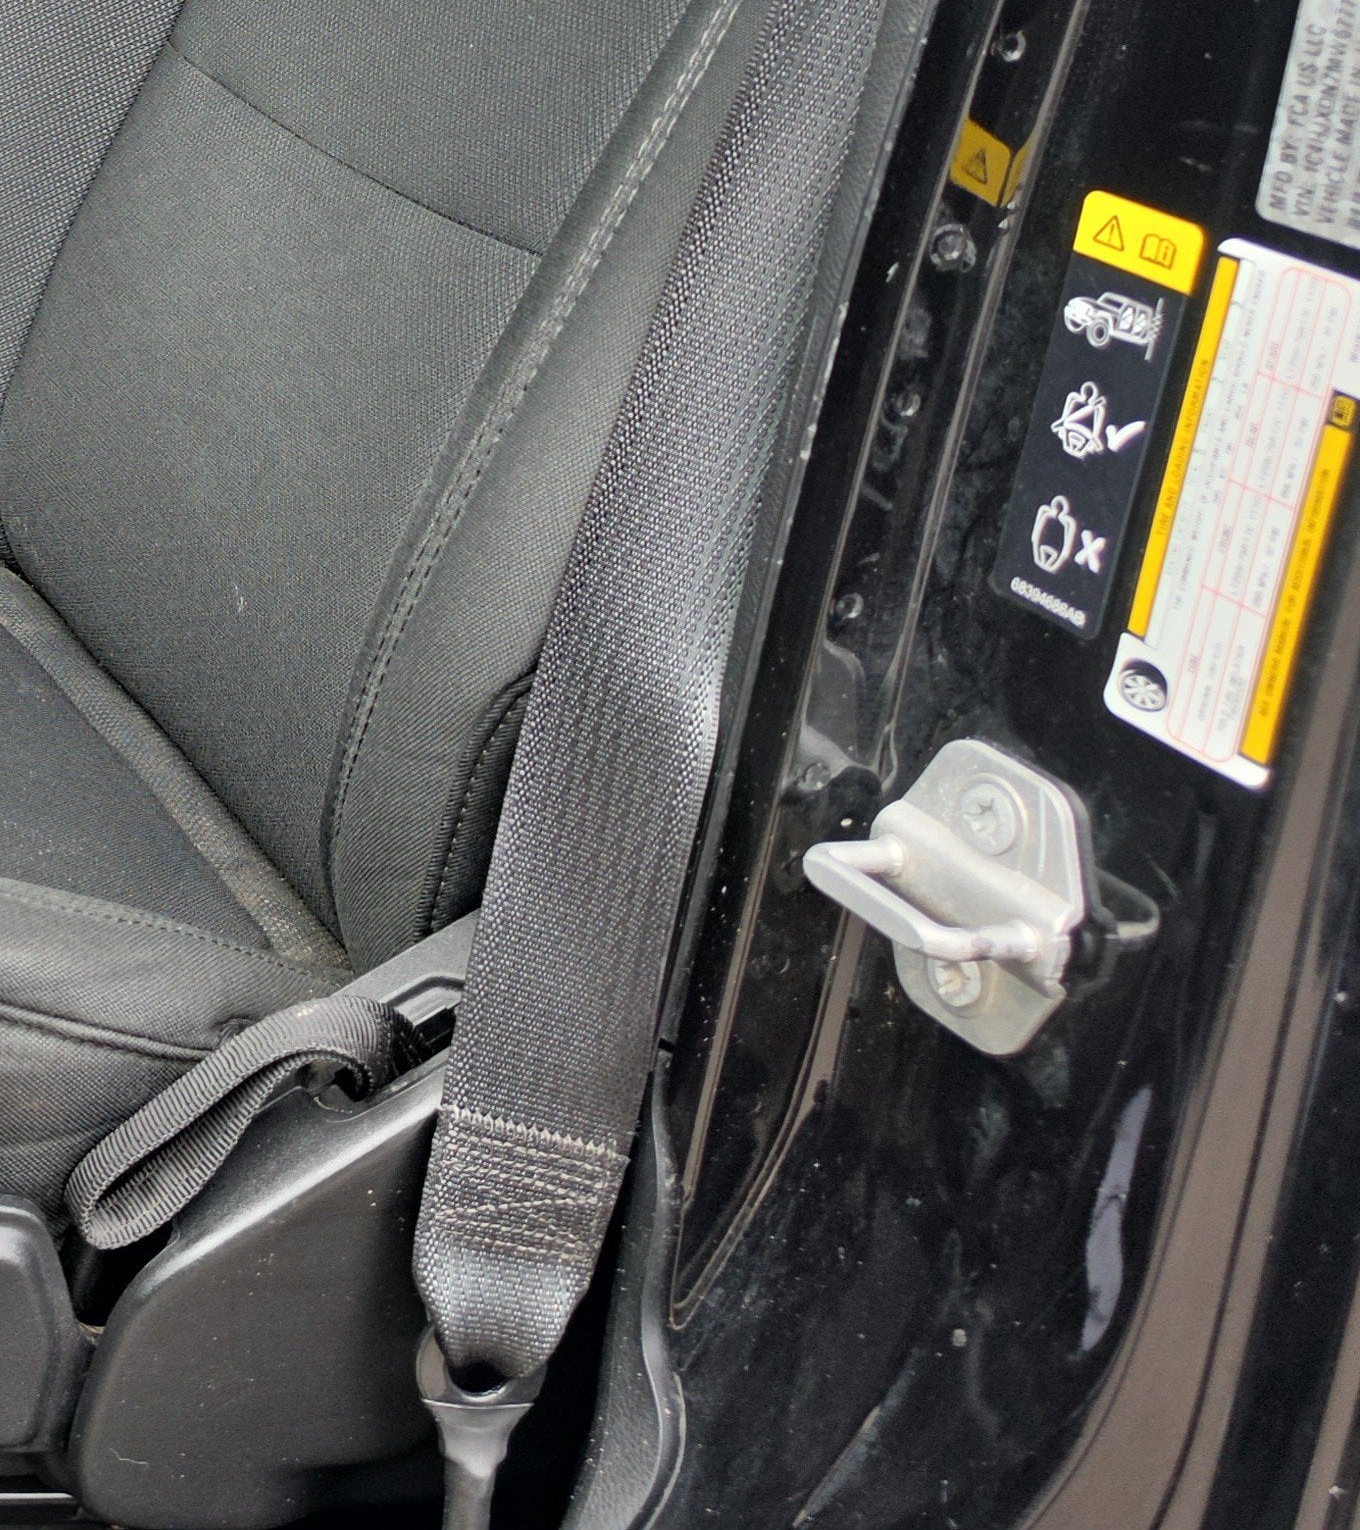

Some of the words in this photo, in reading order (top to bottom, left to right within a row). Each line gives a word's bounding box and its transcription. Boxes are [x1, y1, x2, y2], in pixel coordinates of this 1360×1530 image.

[1304, 24, 1327, 56] LLC
[1297, 63, 1318, 87] US
[1288, 95, 1309, 126] FCA
[1317, 151, 1350, 223] VEHICLE
